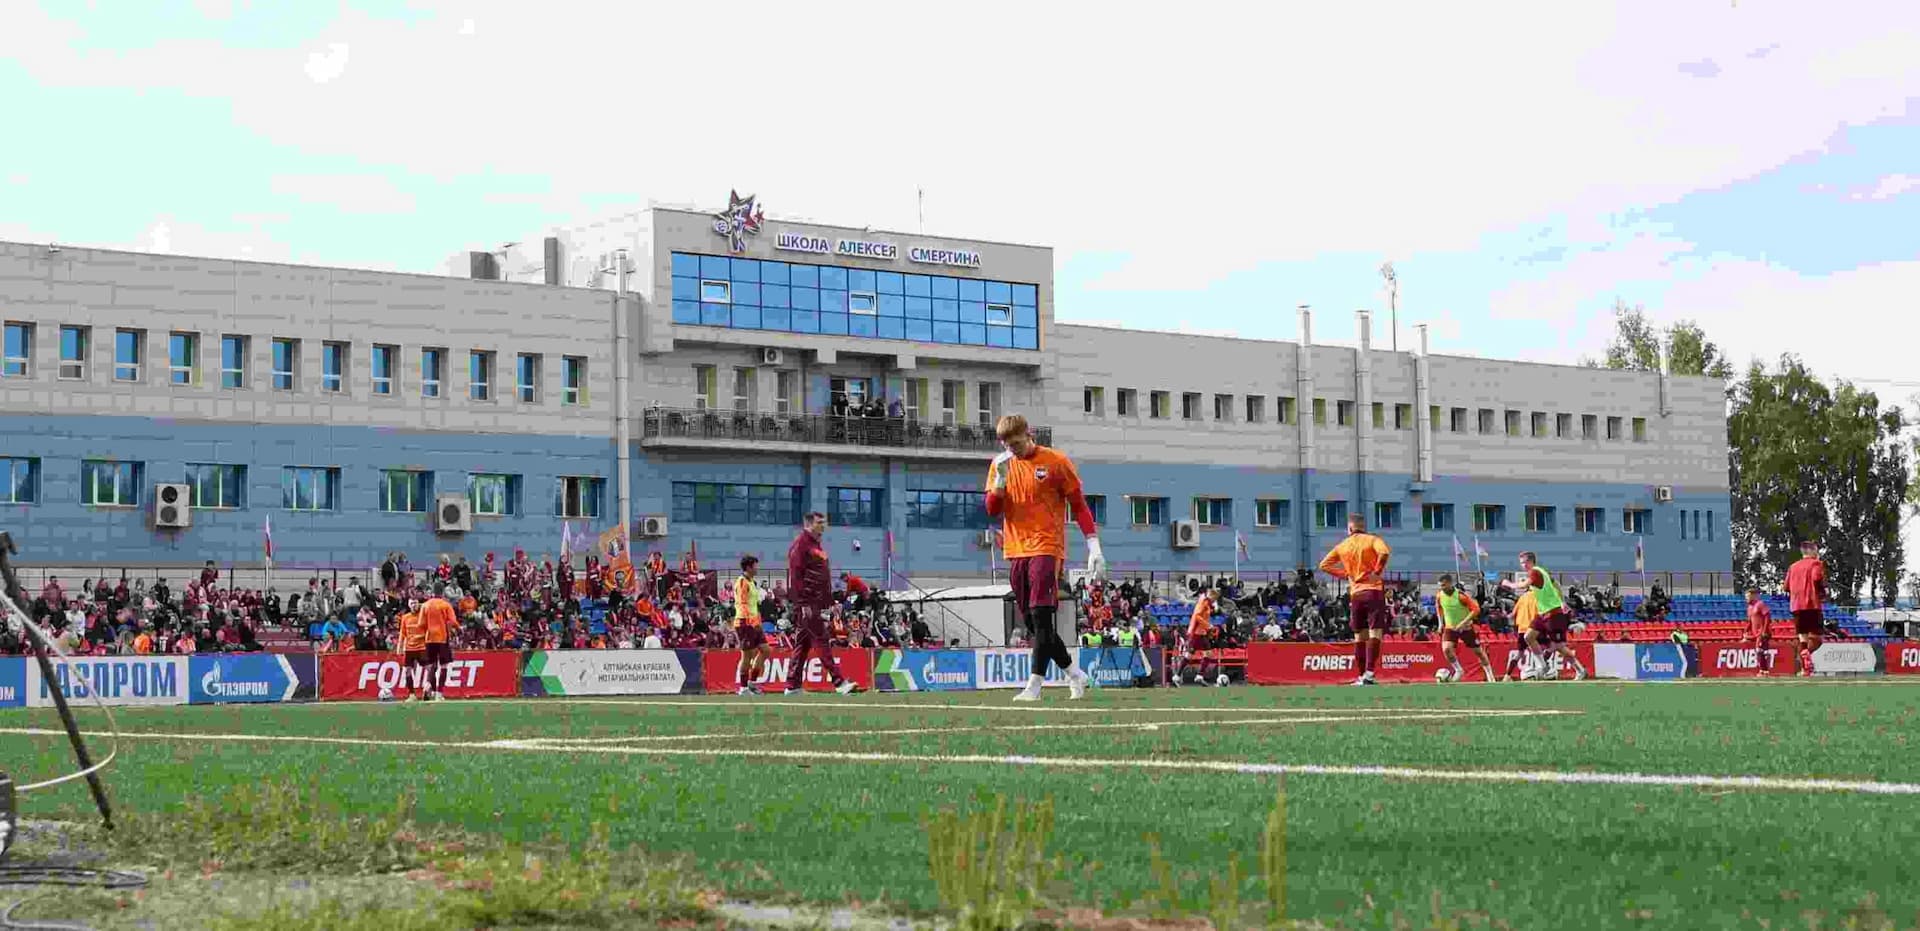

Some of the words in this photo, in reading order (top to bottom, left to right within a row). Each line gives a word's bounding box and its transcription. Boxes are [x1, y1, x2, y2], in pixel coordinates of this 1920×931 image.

[778, 234, 829, 252] ШКОЛА
[838, 241, 897, 257] АЛЕКСЕЯ
[911, 247, 980, 265] СМЕРТИНА
[1303, 655, 1356, 670] FONBET
[1381, 654, 1405, 663] КУБОК
[1406, 654, 1434, 663] РОССИИ
[1717, 649, 1778, 669] FONBT
[1901, 648, 1920, 667] FO
[358, 660, 485, 689] FONET
[984, 653, 1066, 682] ГАЗП
[222, 682, 268, 696] ГАЗПРОМ
